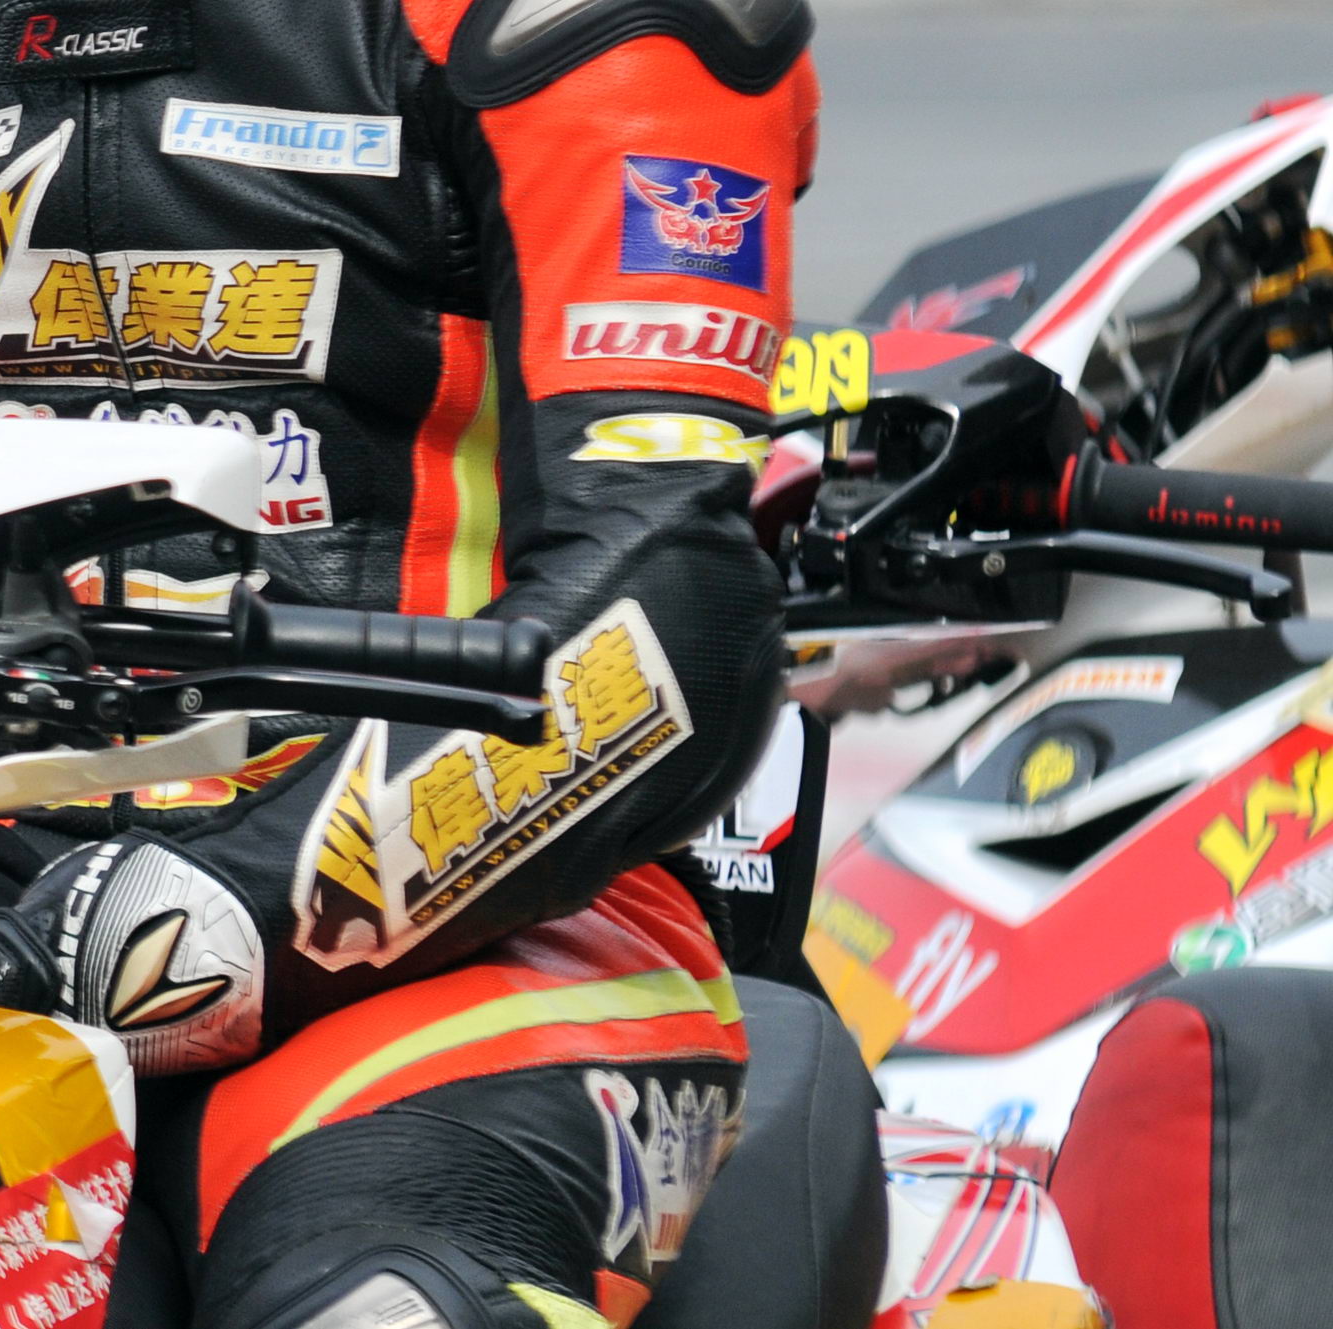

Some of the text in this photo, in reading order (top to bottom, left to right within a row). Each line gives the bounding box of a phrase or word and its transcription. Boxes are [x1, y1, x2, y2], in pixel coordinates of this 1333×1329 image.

[173, 107, 347, 151] Frando
[1146, 486, 1283, 535] domino
[49, 842, 124, 1024] AICHI
